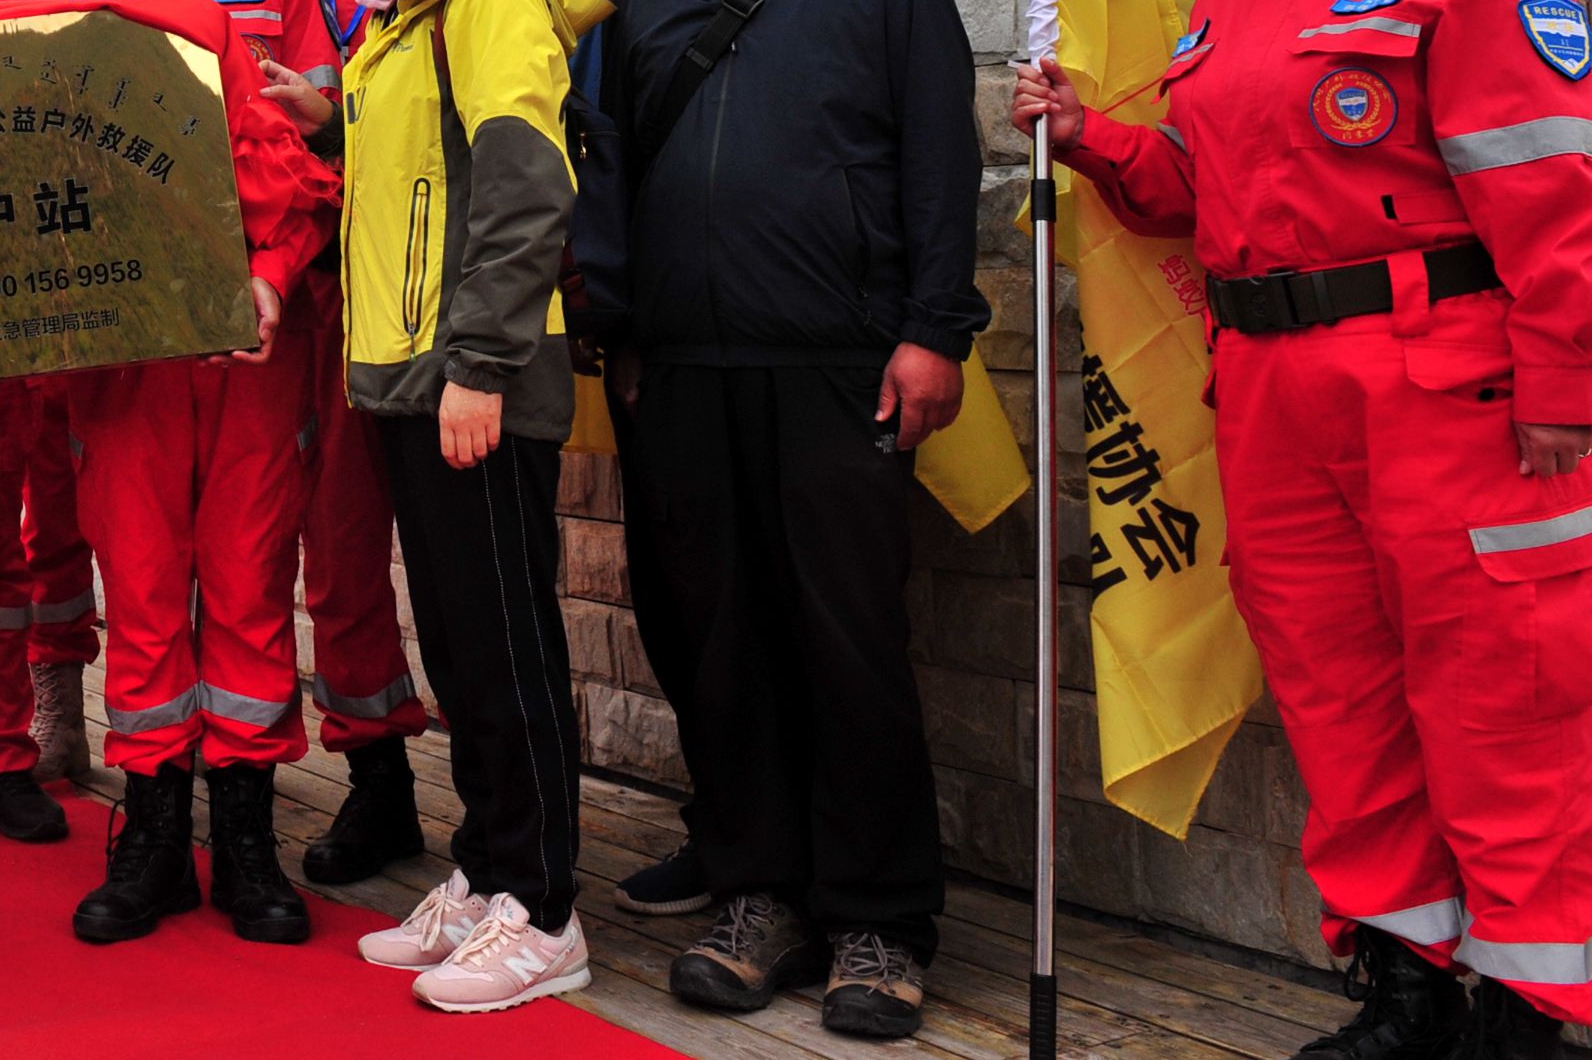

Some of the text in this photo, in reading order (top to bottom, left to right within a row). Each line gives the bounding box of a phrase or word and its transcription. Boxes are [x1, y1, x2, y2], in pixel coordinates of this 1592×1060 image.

[1533, 6, 1578, 23] RESCUE
[24, 268, 70, 294] 156
[77, 259, 144, 288] 9958
[1080, 325, 1201, 581] 援协会
